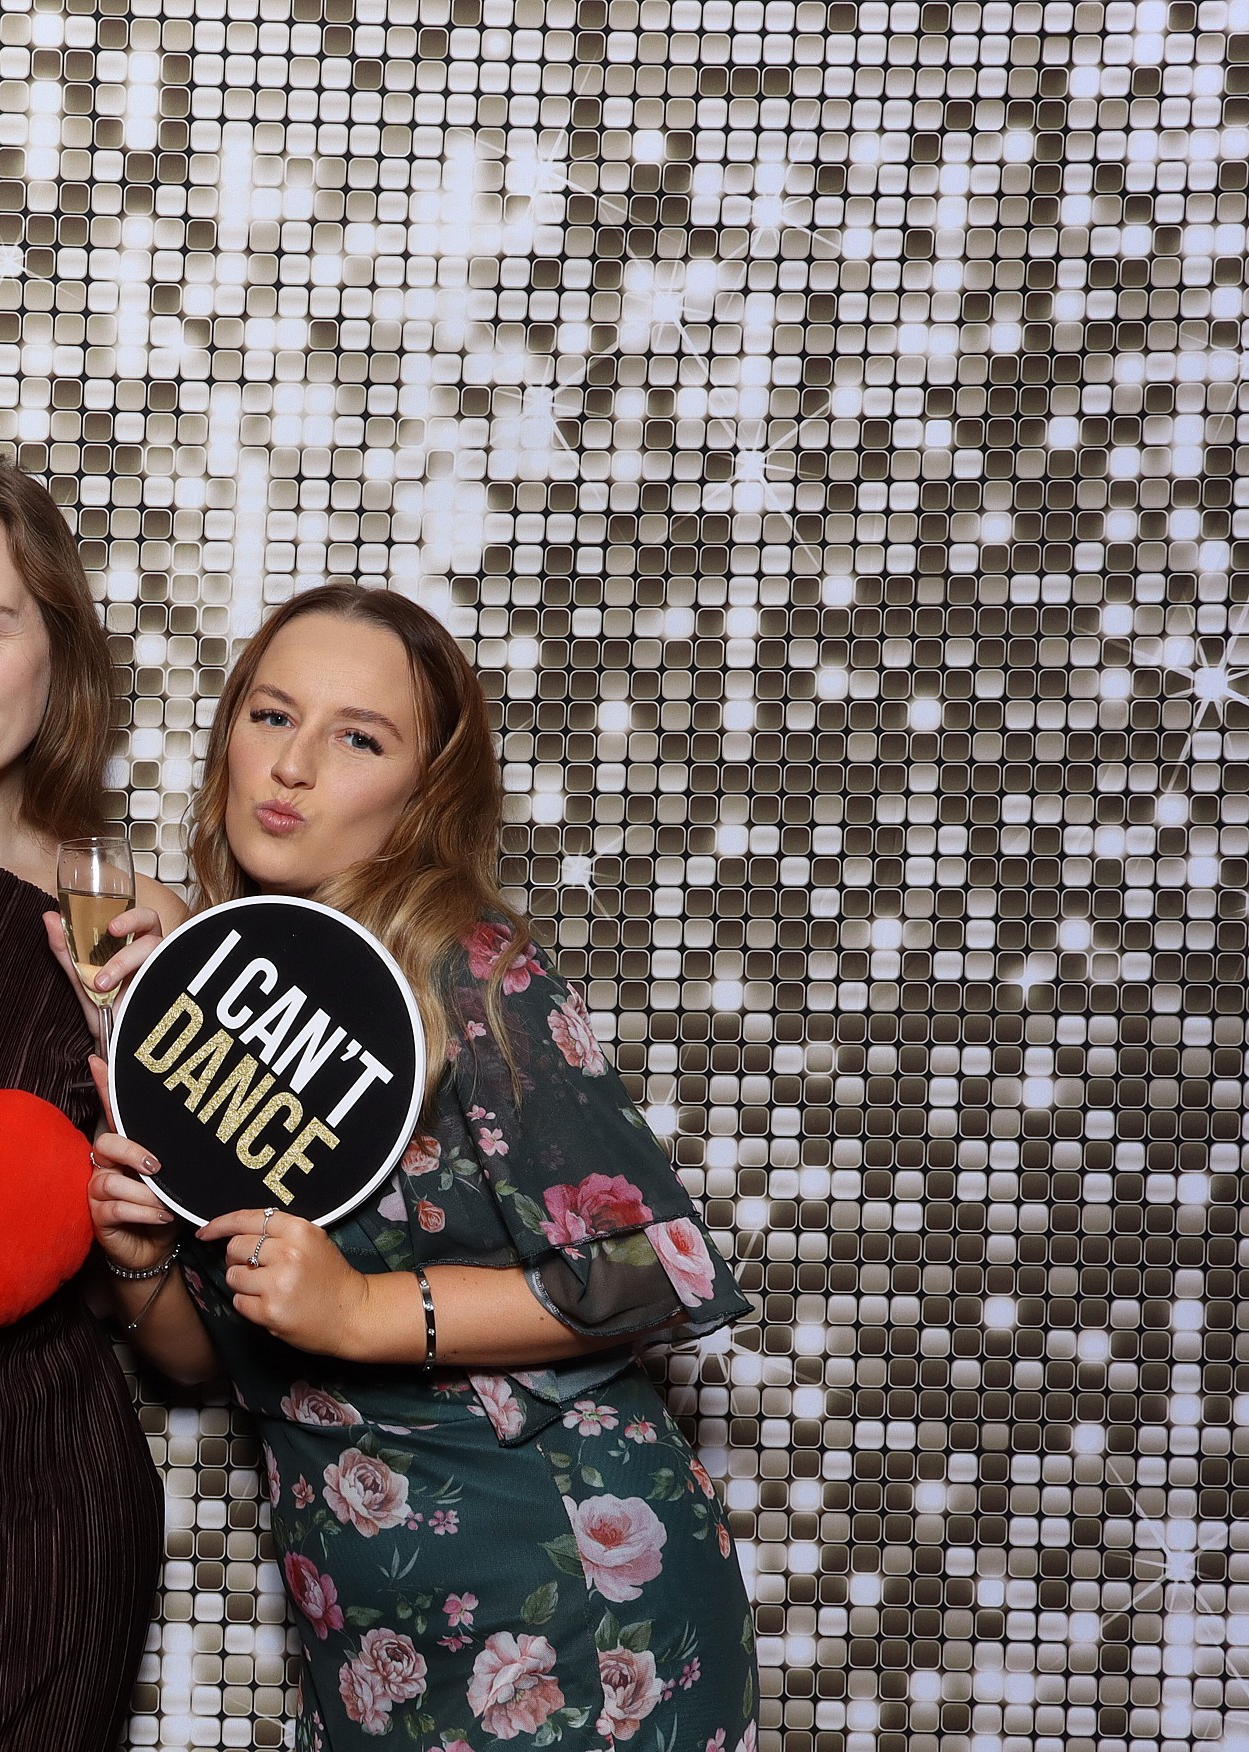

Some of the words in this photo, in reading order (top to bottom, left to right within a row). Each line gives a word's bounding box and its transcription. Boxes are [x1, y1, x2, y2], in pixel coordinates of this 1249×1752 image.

[133, 991, 341, 1206] DANCE
[186, 928, 242, 997] I
[215, 957, 394, 1128] CAN'T
